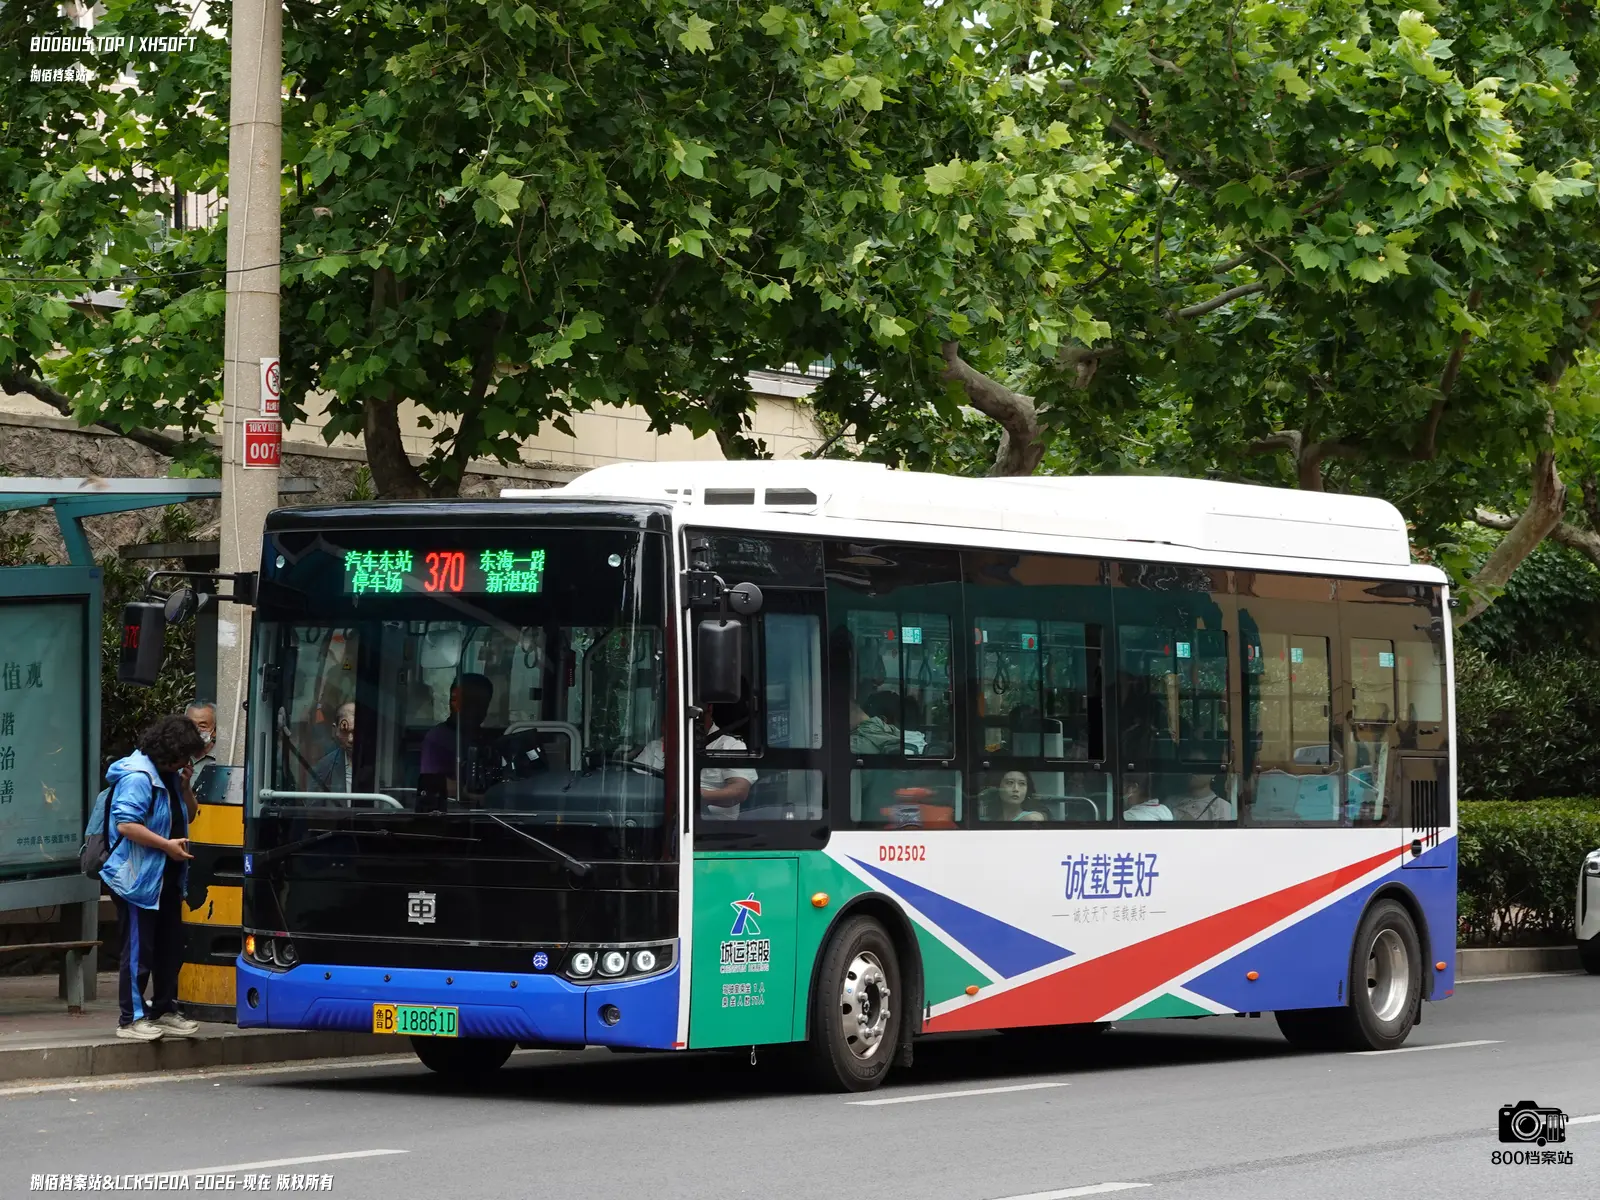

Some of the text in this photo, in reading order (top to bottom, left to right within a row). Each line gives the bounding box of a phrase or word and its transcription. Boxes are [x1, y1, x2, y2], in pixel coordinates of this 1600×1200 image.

[344, 550, 413, 572] 汽车东站
[424, 552, 465, 592] 370
[479, 549, 545, 572] 东海一路
[352, 570, 403, 593] 停车场
[485, 570, 539, 593] 新湛路
[2, 661, 43, 691] 值观
[879, 845, 926, 861] DD2502
[1061, 852, 1159, 900] 诚载美好
[720, 940, 770, 965] 城运控股
[376, 1009, 456, 1033] 鲁B 18861D
